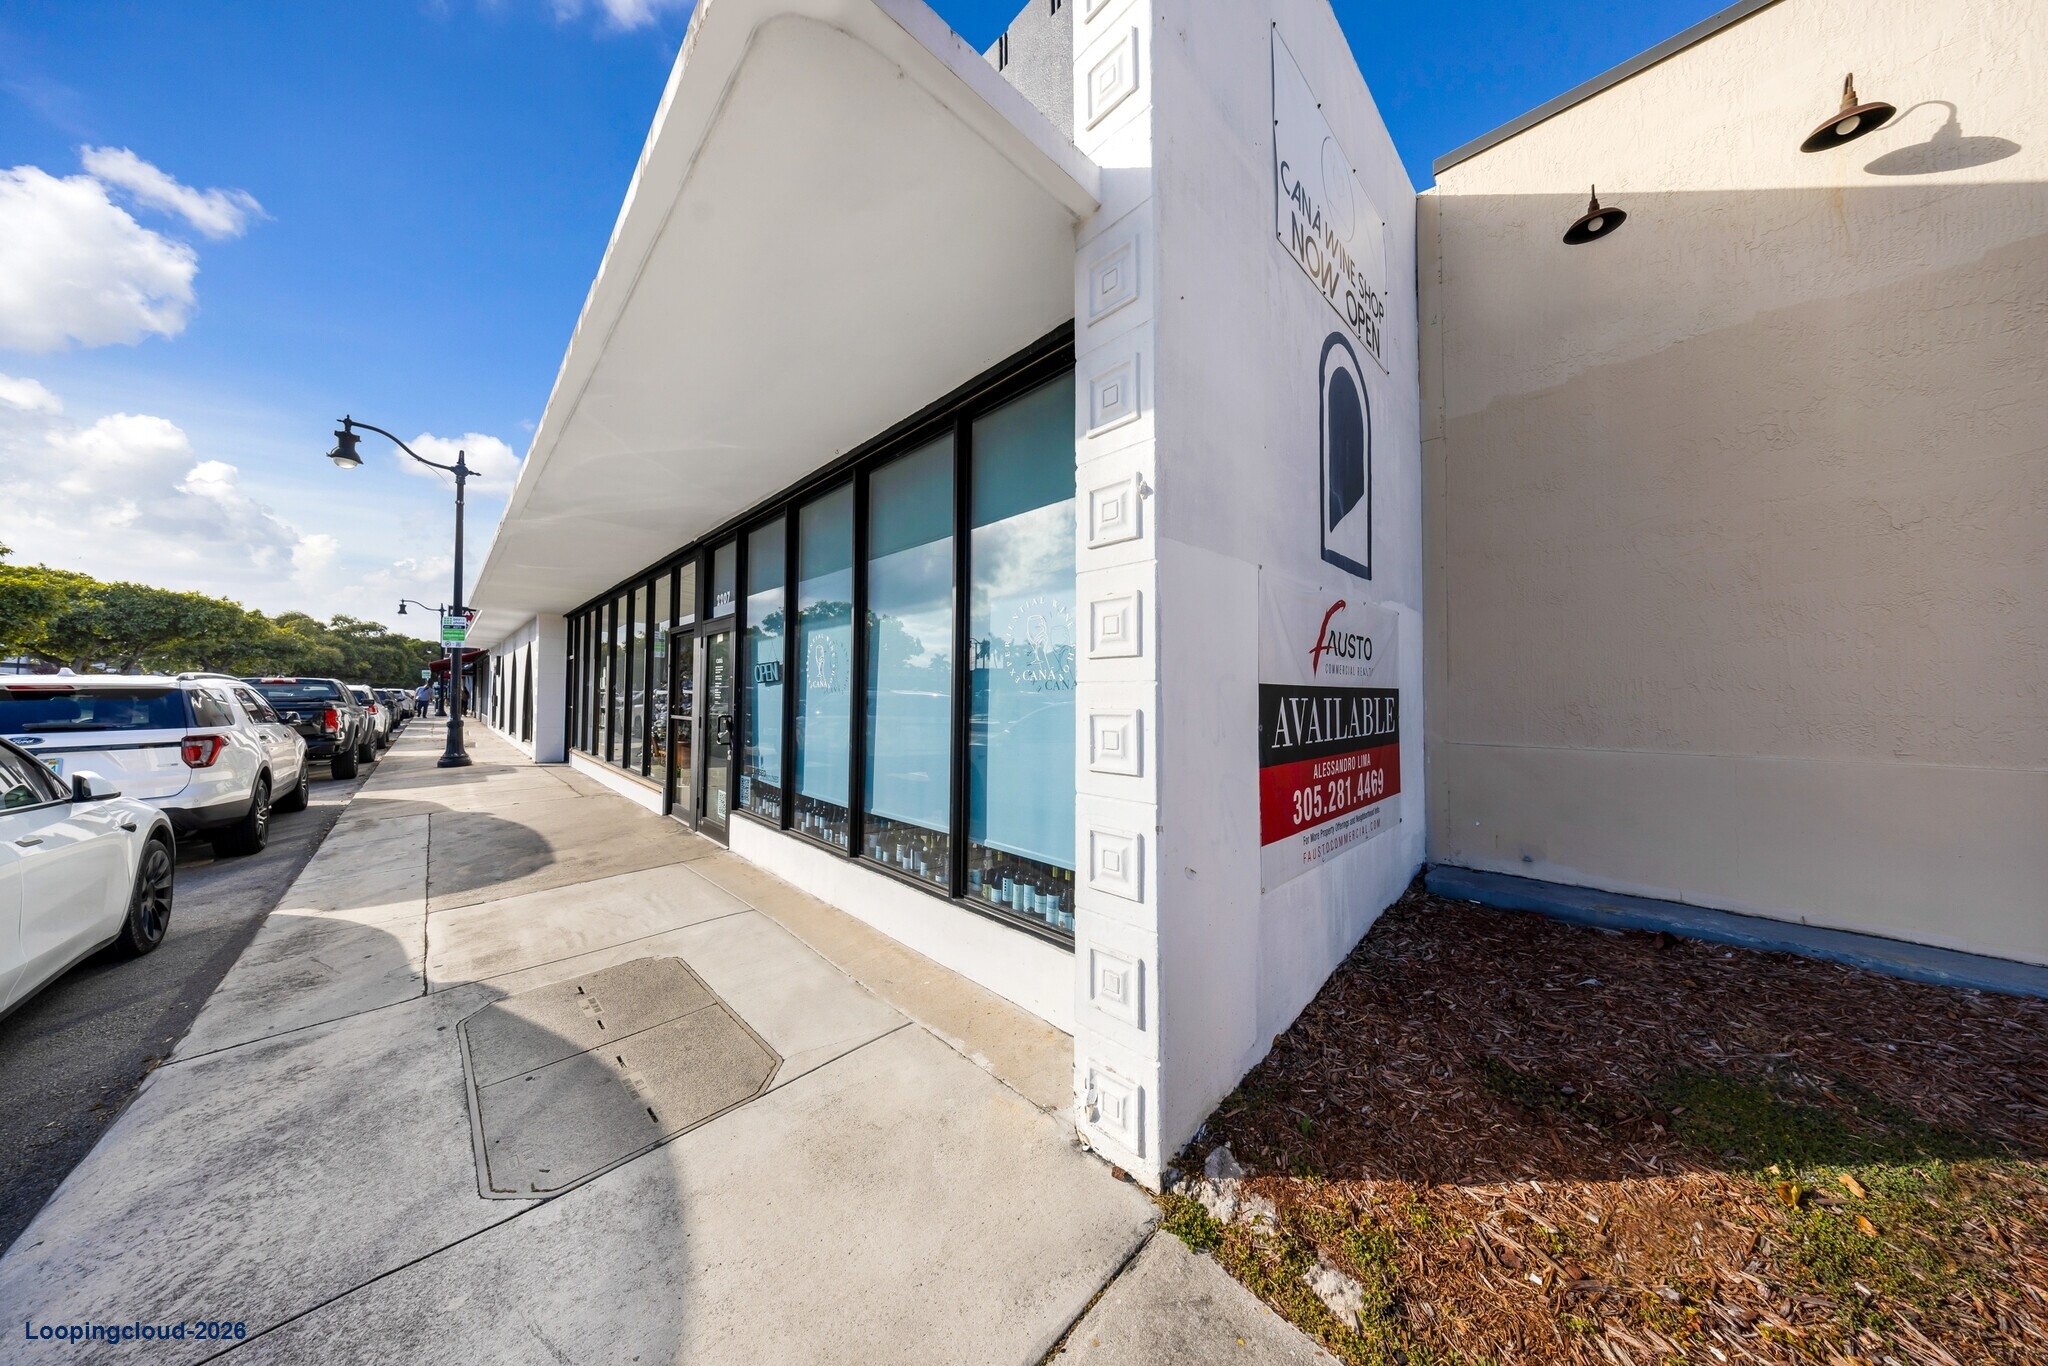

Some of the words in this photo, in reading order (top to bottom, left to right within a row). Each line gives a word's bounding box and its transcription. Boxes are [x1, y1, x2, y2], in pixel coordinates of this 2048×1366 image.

[1291, 210, 1339, 299] NOW
[1346, 289, 1380, 359] OPEN
[1325, 221, 1356, 288] WINE
[1358, 272, 1384, 324] SHOP
[755, 662, 779, 683] OPEN
[1325, 663, 1356, 676] COMMERCIAL
[1271, 696, 1395, 748] AVAILABLE
[1313, 756, 1356, 779] ALESSANDRO
[1357, 753, 1371, 769] LIMA
[1292, 767, 1384, 825] 305.281.4469
[1302, 818, 1381, 864] FAUSTOCOMMERCIAL.COM
[1310, 832, 1320, 843] More
[1320, 826, 1335, 838] Property
